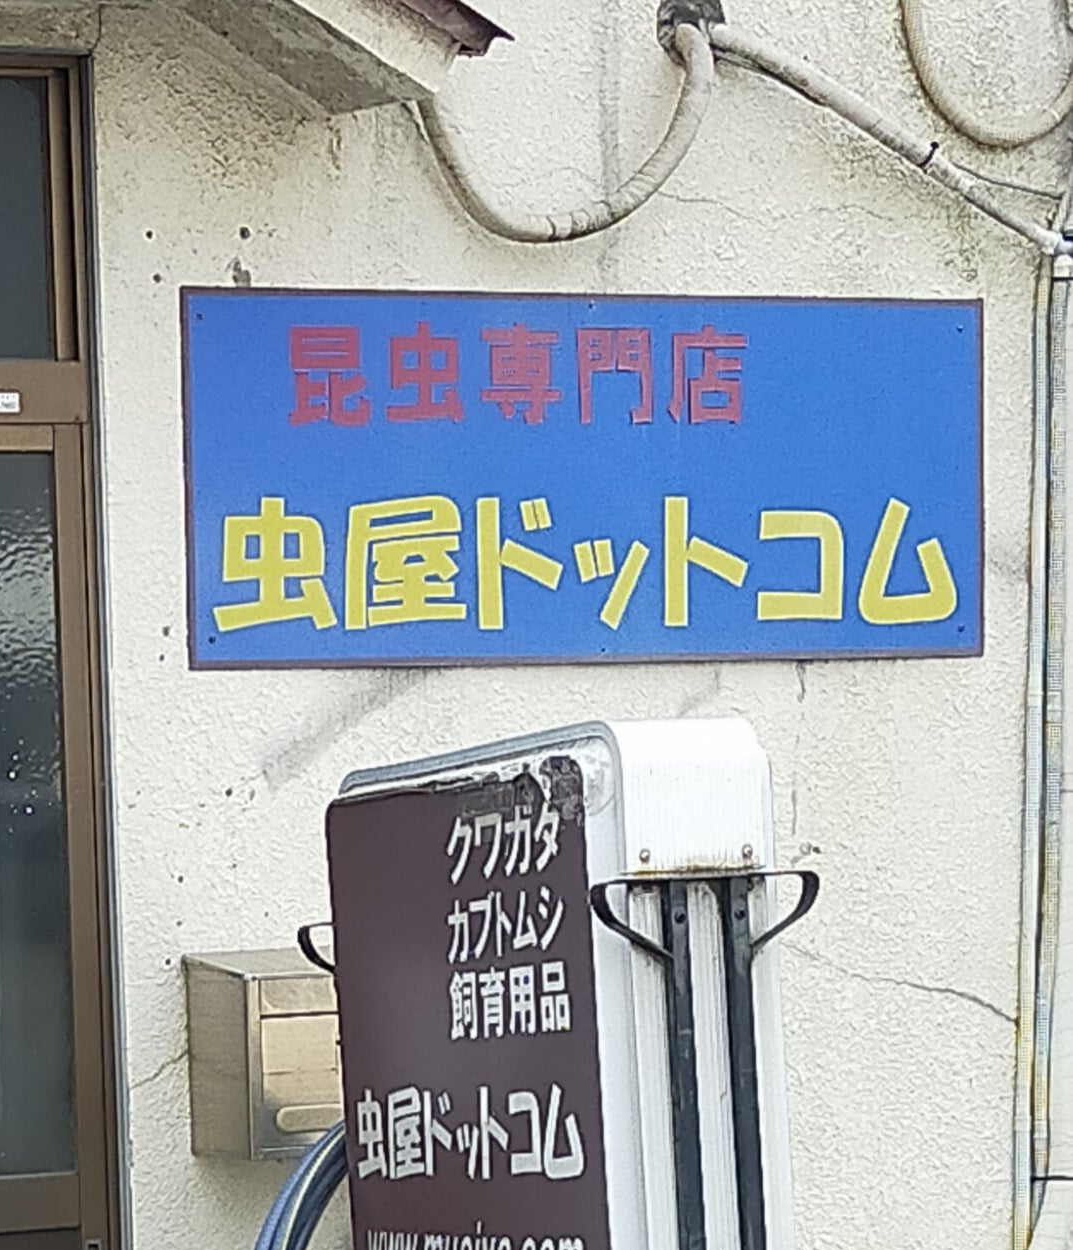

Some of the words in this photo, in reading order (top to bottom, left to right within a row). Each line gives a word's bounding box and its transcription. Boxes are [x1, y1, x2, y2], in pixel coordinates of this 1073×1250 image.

[289, 320, 748, 427] 昆虫専門店
[213, 494, 958, 632] 虫屋ドットコム
[446, 801, 561, 886] クワガタ
[447, 886, 565, 964] カブトムシ
[448, 960, 572, 1041] 飼育用品
[356, 1082, 585, 1181] 虫屋ドットコム
